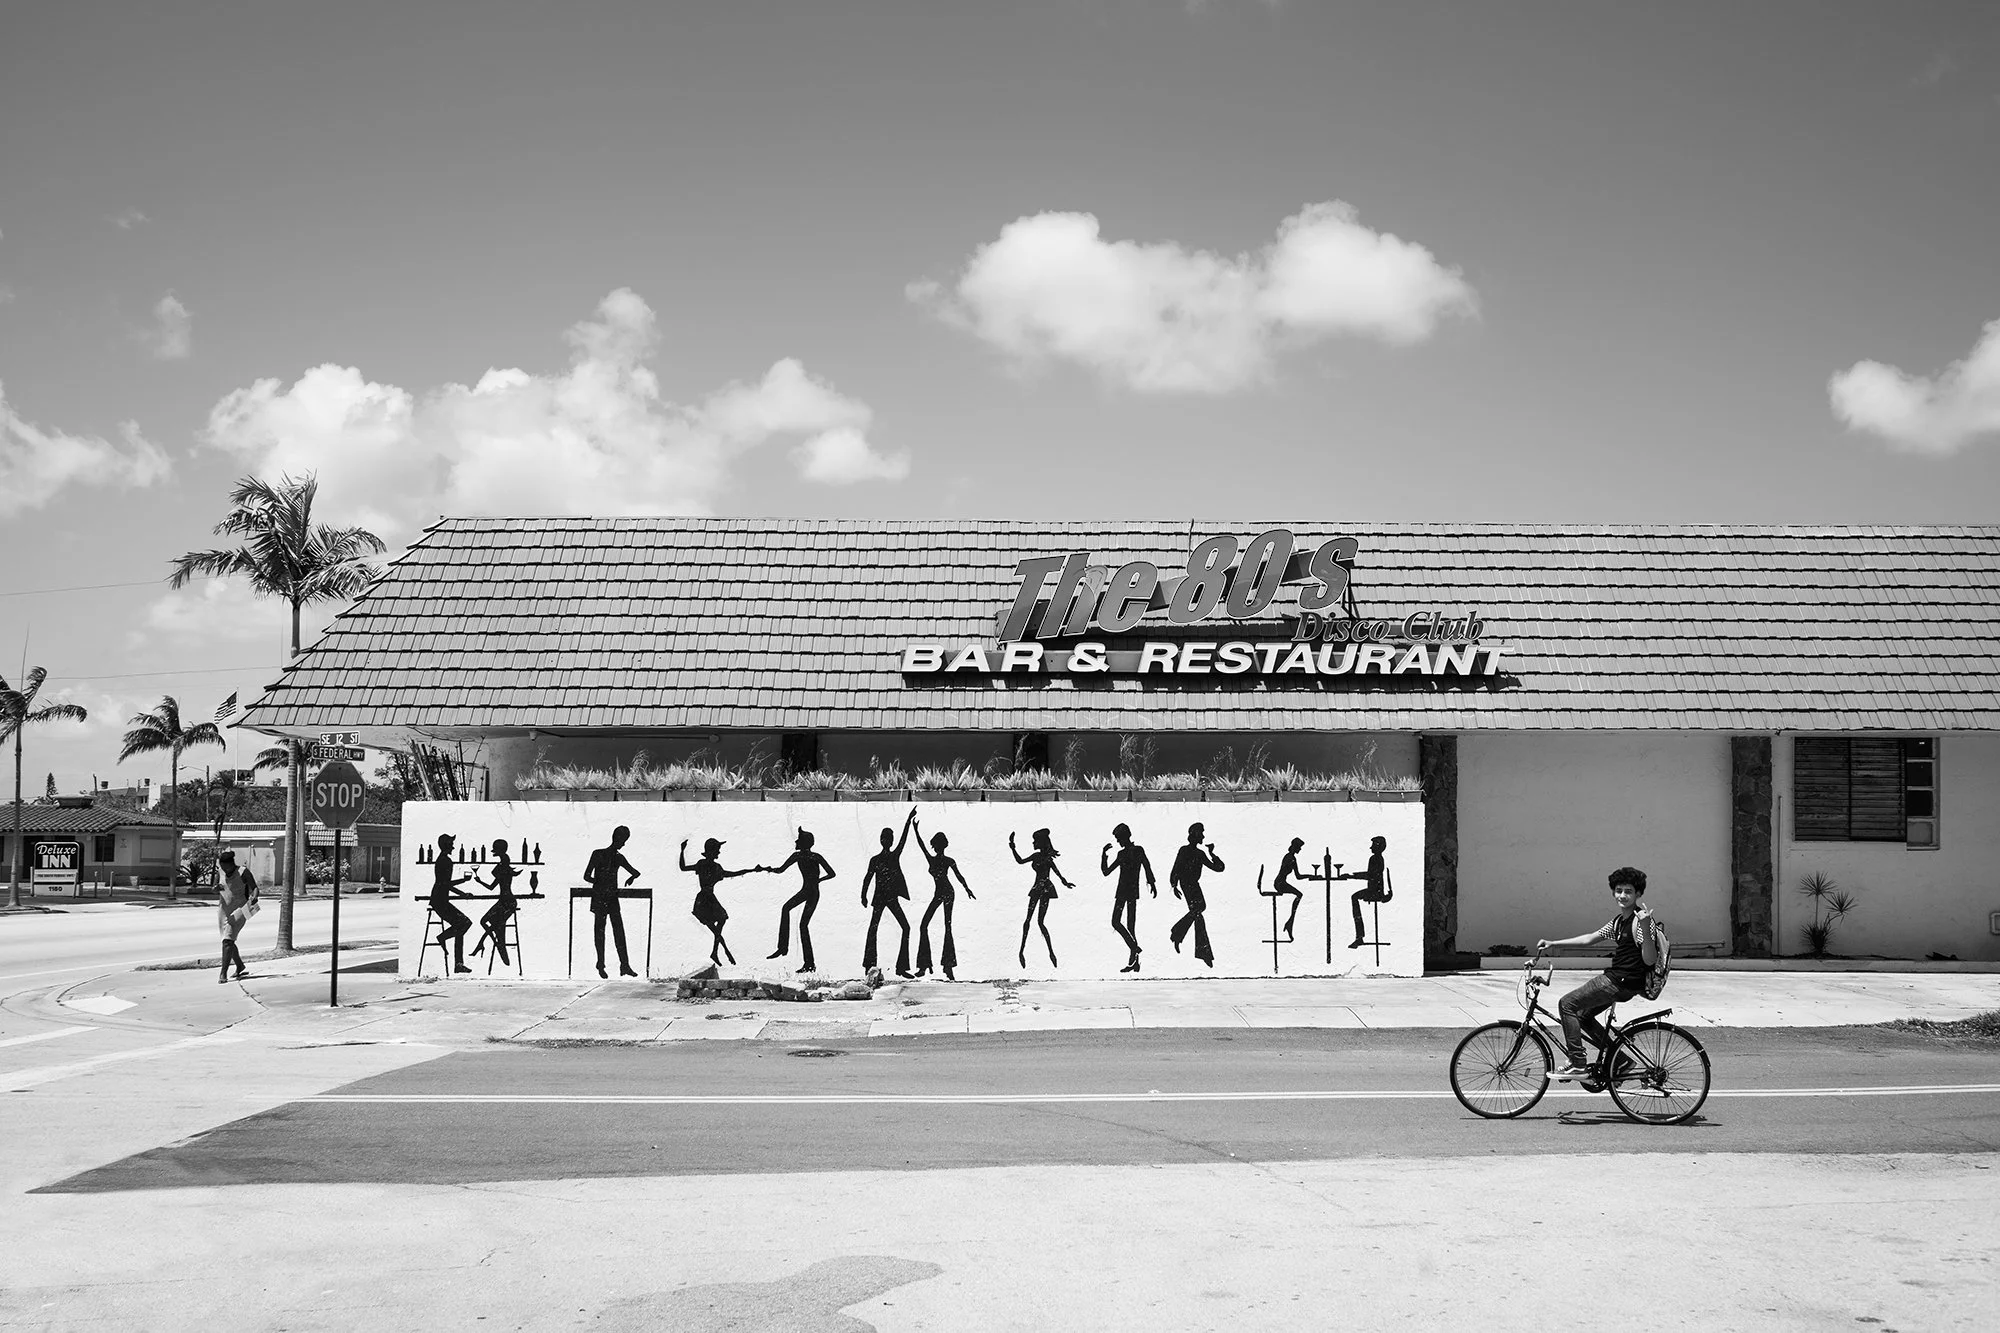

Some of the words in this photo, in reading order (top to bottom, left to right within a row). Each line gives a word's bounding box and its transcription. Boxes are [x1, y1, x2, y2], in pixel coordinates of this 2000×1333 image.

[998, 552, 1158, 643] The
[1291, 611, 1391, 642] Disco
[1402, 610, 1484, 642] Club
[901, 642, 1044, 673] BAR
[1067, 642, 1110, 673] &
[1138, 642, 1514, 676] RESTAURANT
[321, 734, 331, 745] SE
[336, 733, 344, 744] 12
[350, 733, 359, 744] ST
[319, 747, 353, 759] FEDERAL
[315, 782, 362, 808] STOP
[37, 844, 76, 854] Deluxe
[42, 854, 71, 868] INN
